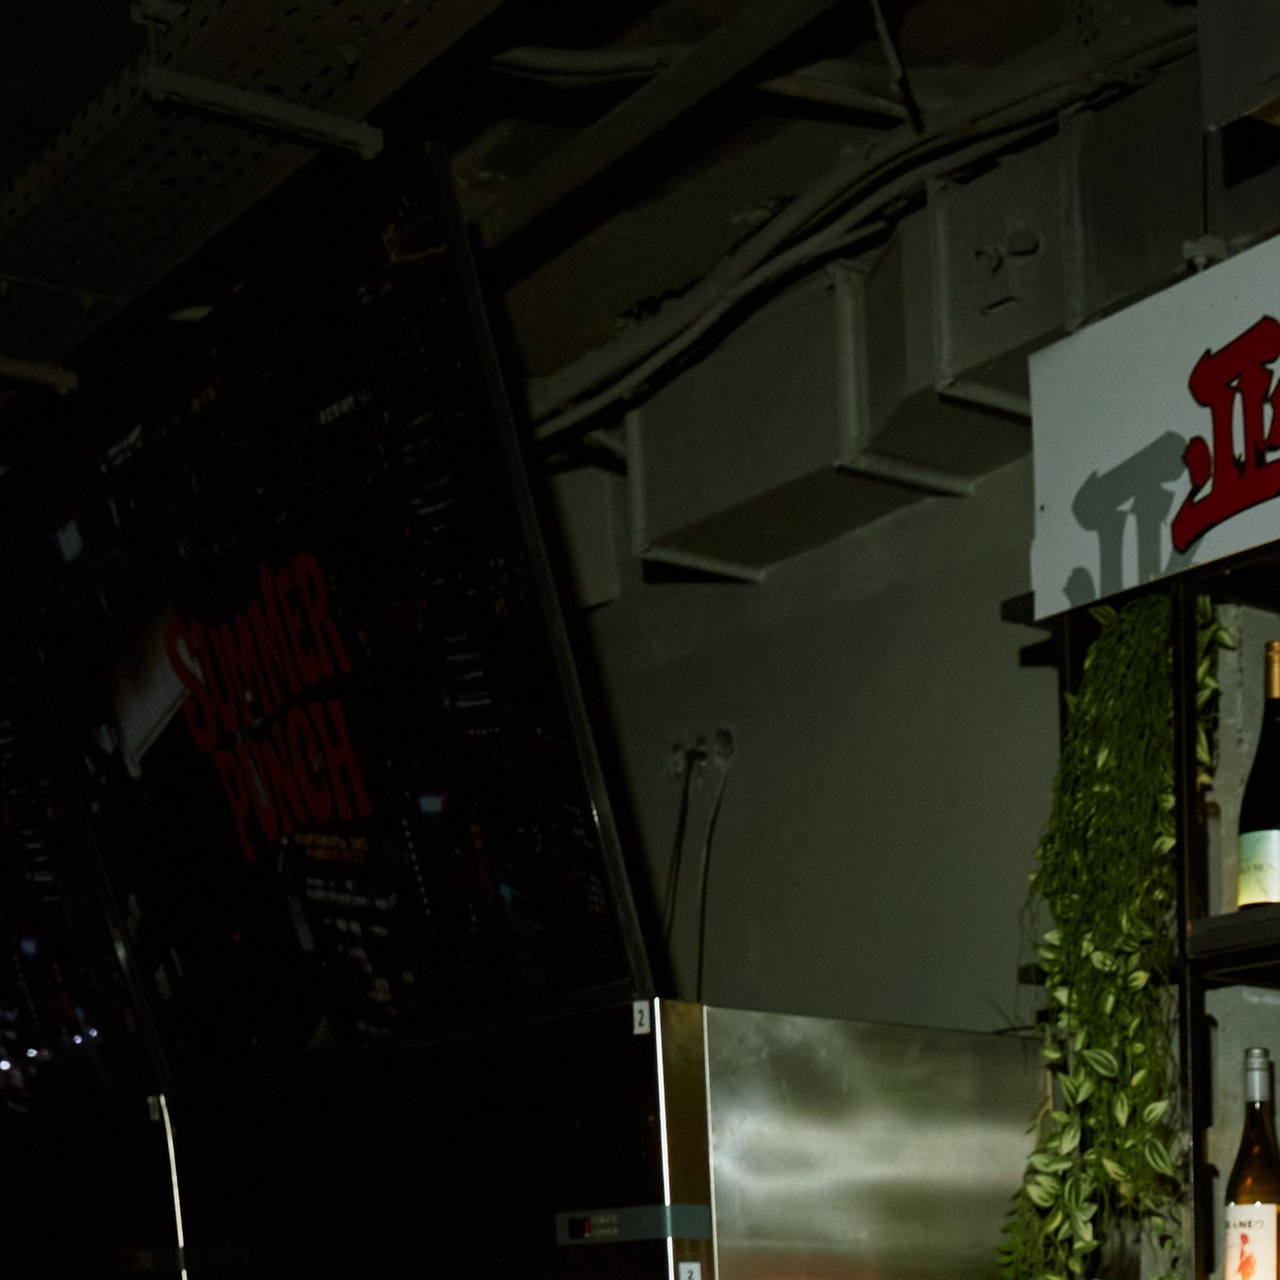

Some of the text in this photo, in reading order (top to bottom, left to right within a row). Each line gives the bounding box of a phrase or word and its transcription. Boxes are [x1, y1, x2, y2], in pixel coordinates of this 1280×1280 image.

[164, 553, 352, 754] SUMMER
[213, 699, 374, 864] PUNCH
[638, 1009, 645, 1027] 2
[686, 1270, 694, 1280] 2
